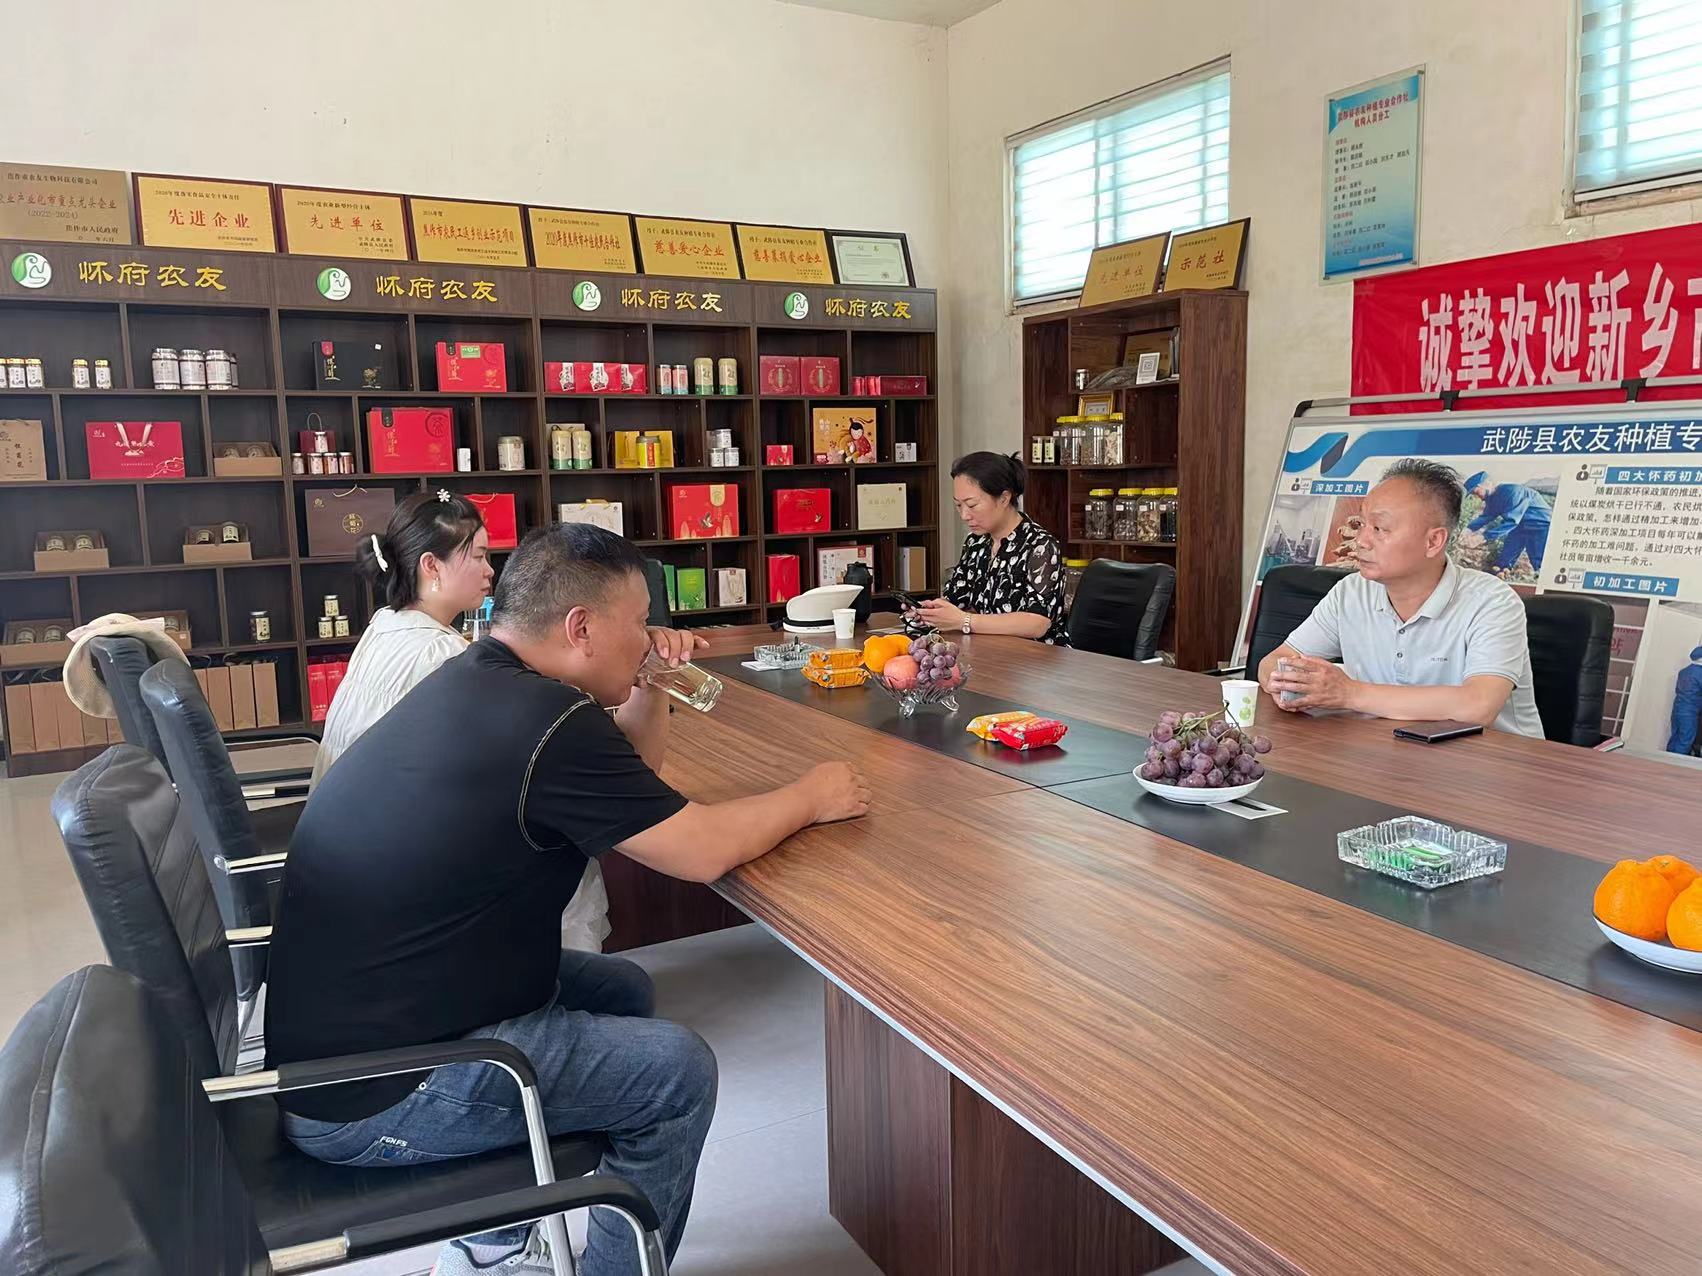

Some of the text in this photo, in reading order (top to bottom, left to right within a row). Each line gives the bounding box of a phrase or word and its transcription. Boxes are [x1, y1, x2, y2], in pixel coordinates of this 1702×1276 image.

[168, 209, 250, 229] 先进企业
[309, 214, 384, 232] 先进单位
[654, 239, 725, 257] 慈善爱心企业
[1180, 250, 1224, 271] 示范社
[79, 261, 227, 291] 怀府农友
[376, 275, 498, 302] 怀府农友
[621, 288, 723, 313] 怀府农友
[825, 298, 912, 319] 怀府农友
[1481, 422, 1702, 453] 武陟县农友种植专
[1315, 483, 1364, 493] 深加工图片
[1593, 575, 1668, 593] 初加工图片
